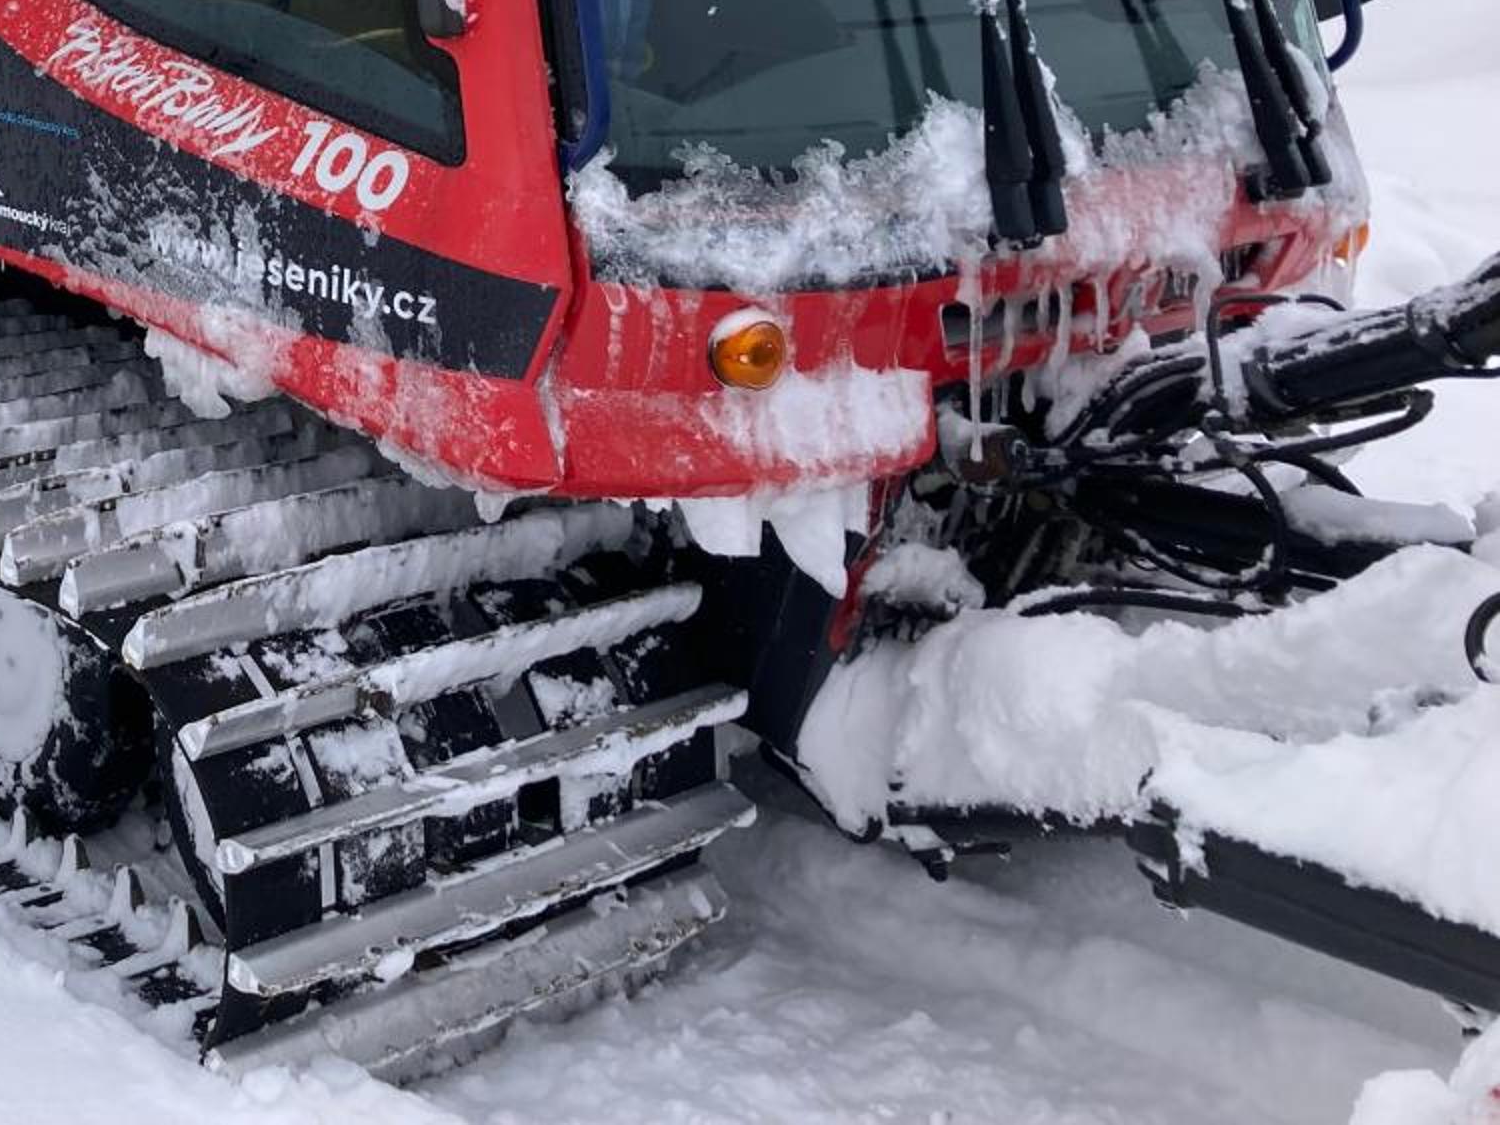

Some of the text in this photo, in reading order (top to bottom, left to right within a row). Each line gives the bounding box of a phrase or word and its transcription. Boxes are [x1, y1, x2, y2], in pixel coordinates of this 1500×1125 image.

[289, 120, 409, 211] 100
[49, 215, 71, 238] kraj
[148, 225, 438, 325] wwwjeseniky.cz
